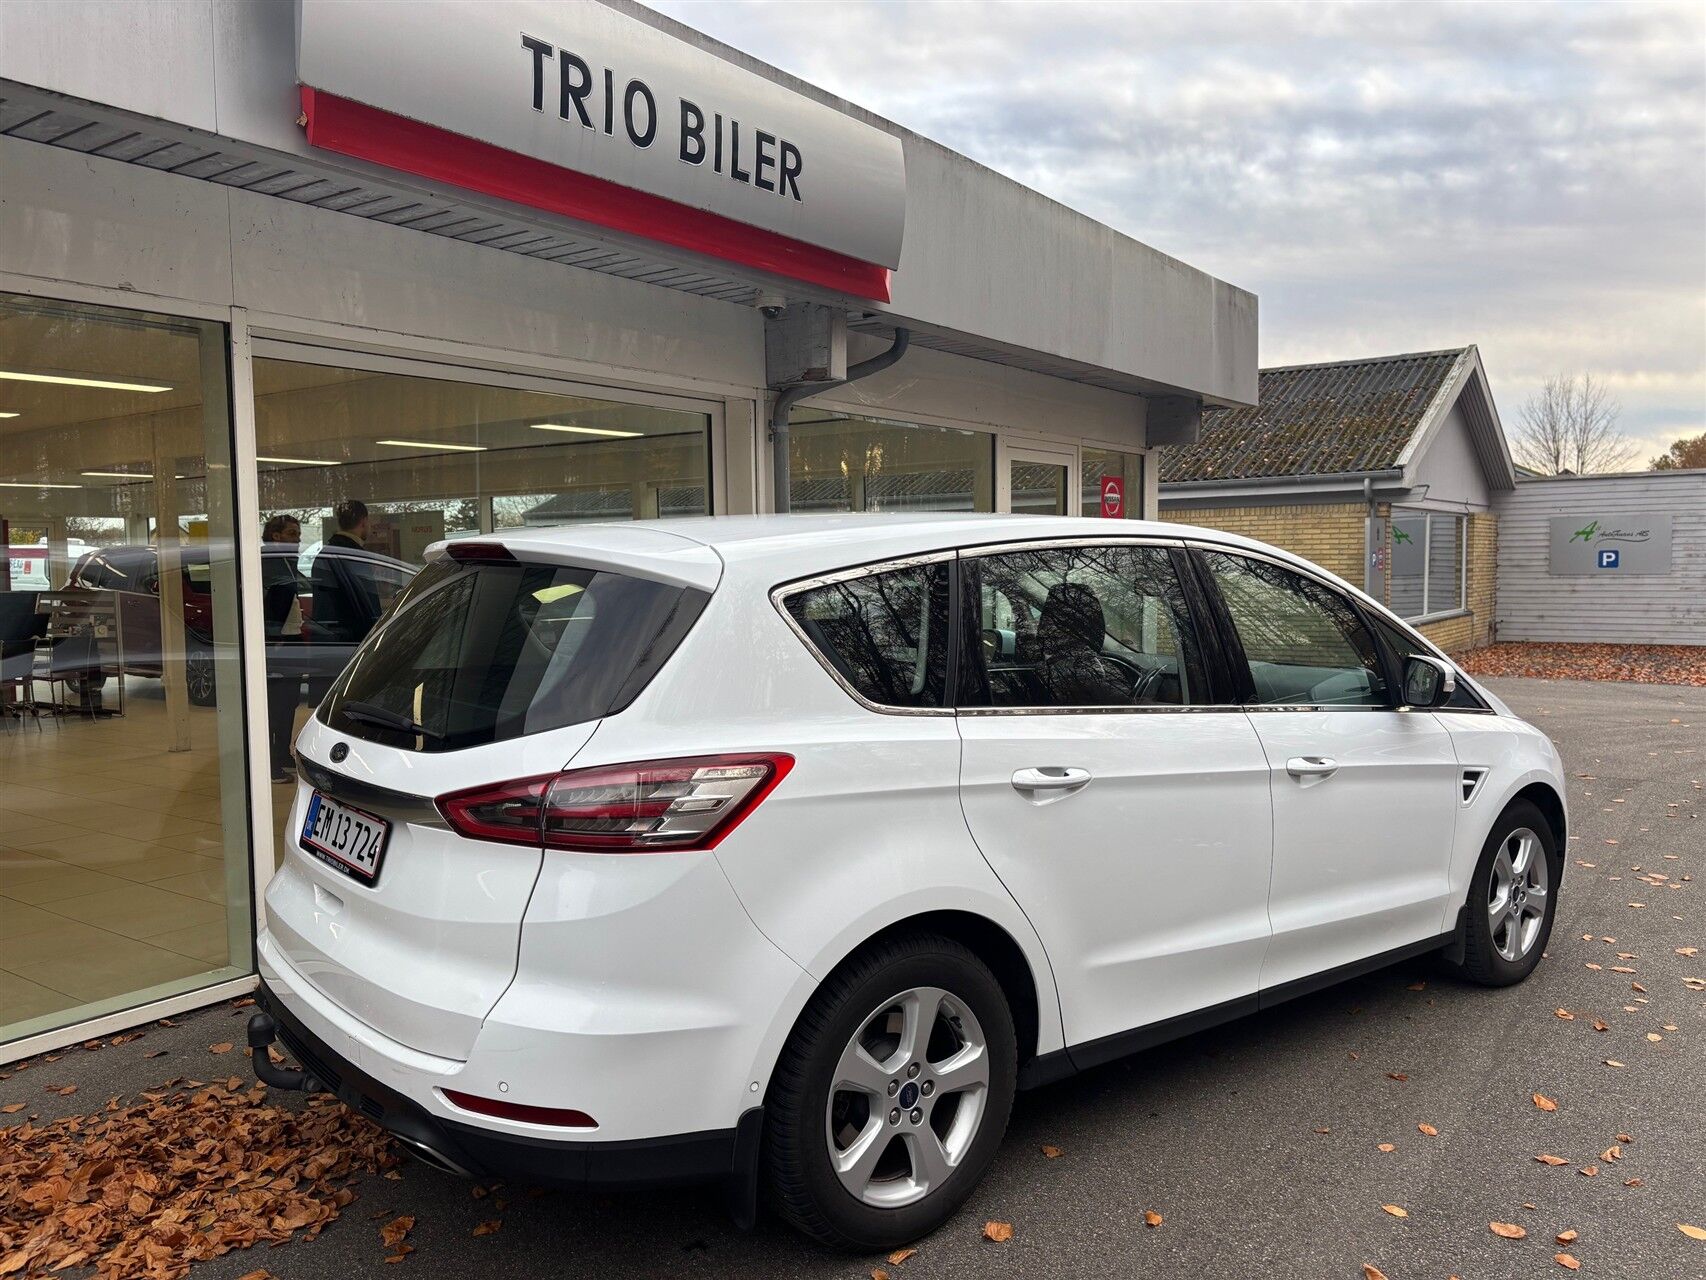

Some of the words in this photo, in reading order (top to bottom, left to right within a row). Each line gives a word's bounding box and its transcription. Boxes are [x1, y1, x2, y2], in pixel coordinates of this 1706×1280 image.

[522, 33, 657, 149] TRIO
[679, 97, 803, 203] BILER
[1602, 552, 1615, 566] P
[313, 804, 335, 842] EM
[331, 813, 351, 850] 13
[349, 821, 381, 867] 724
